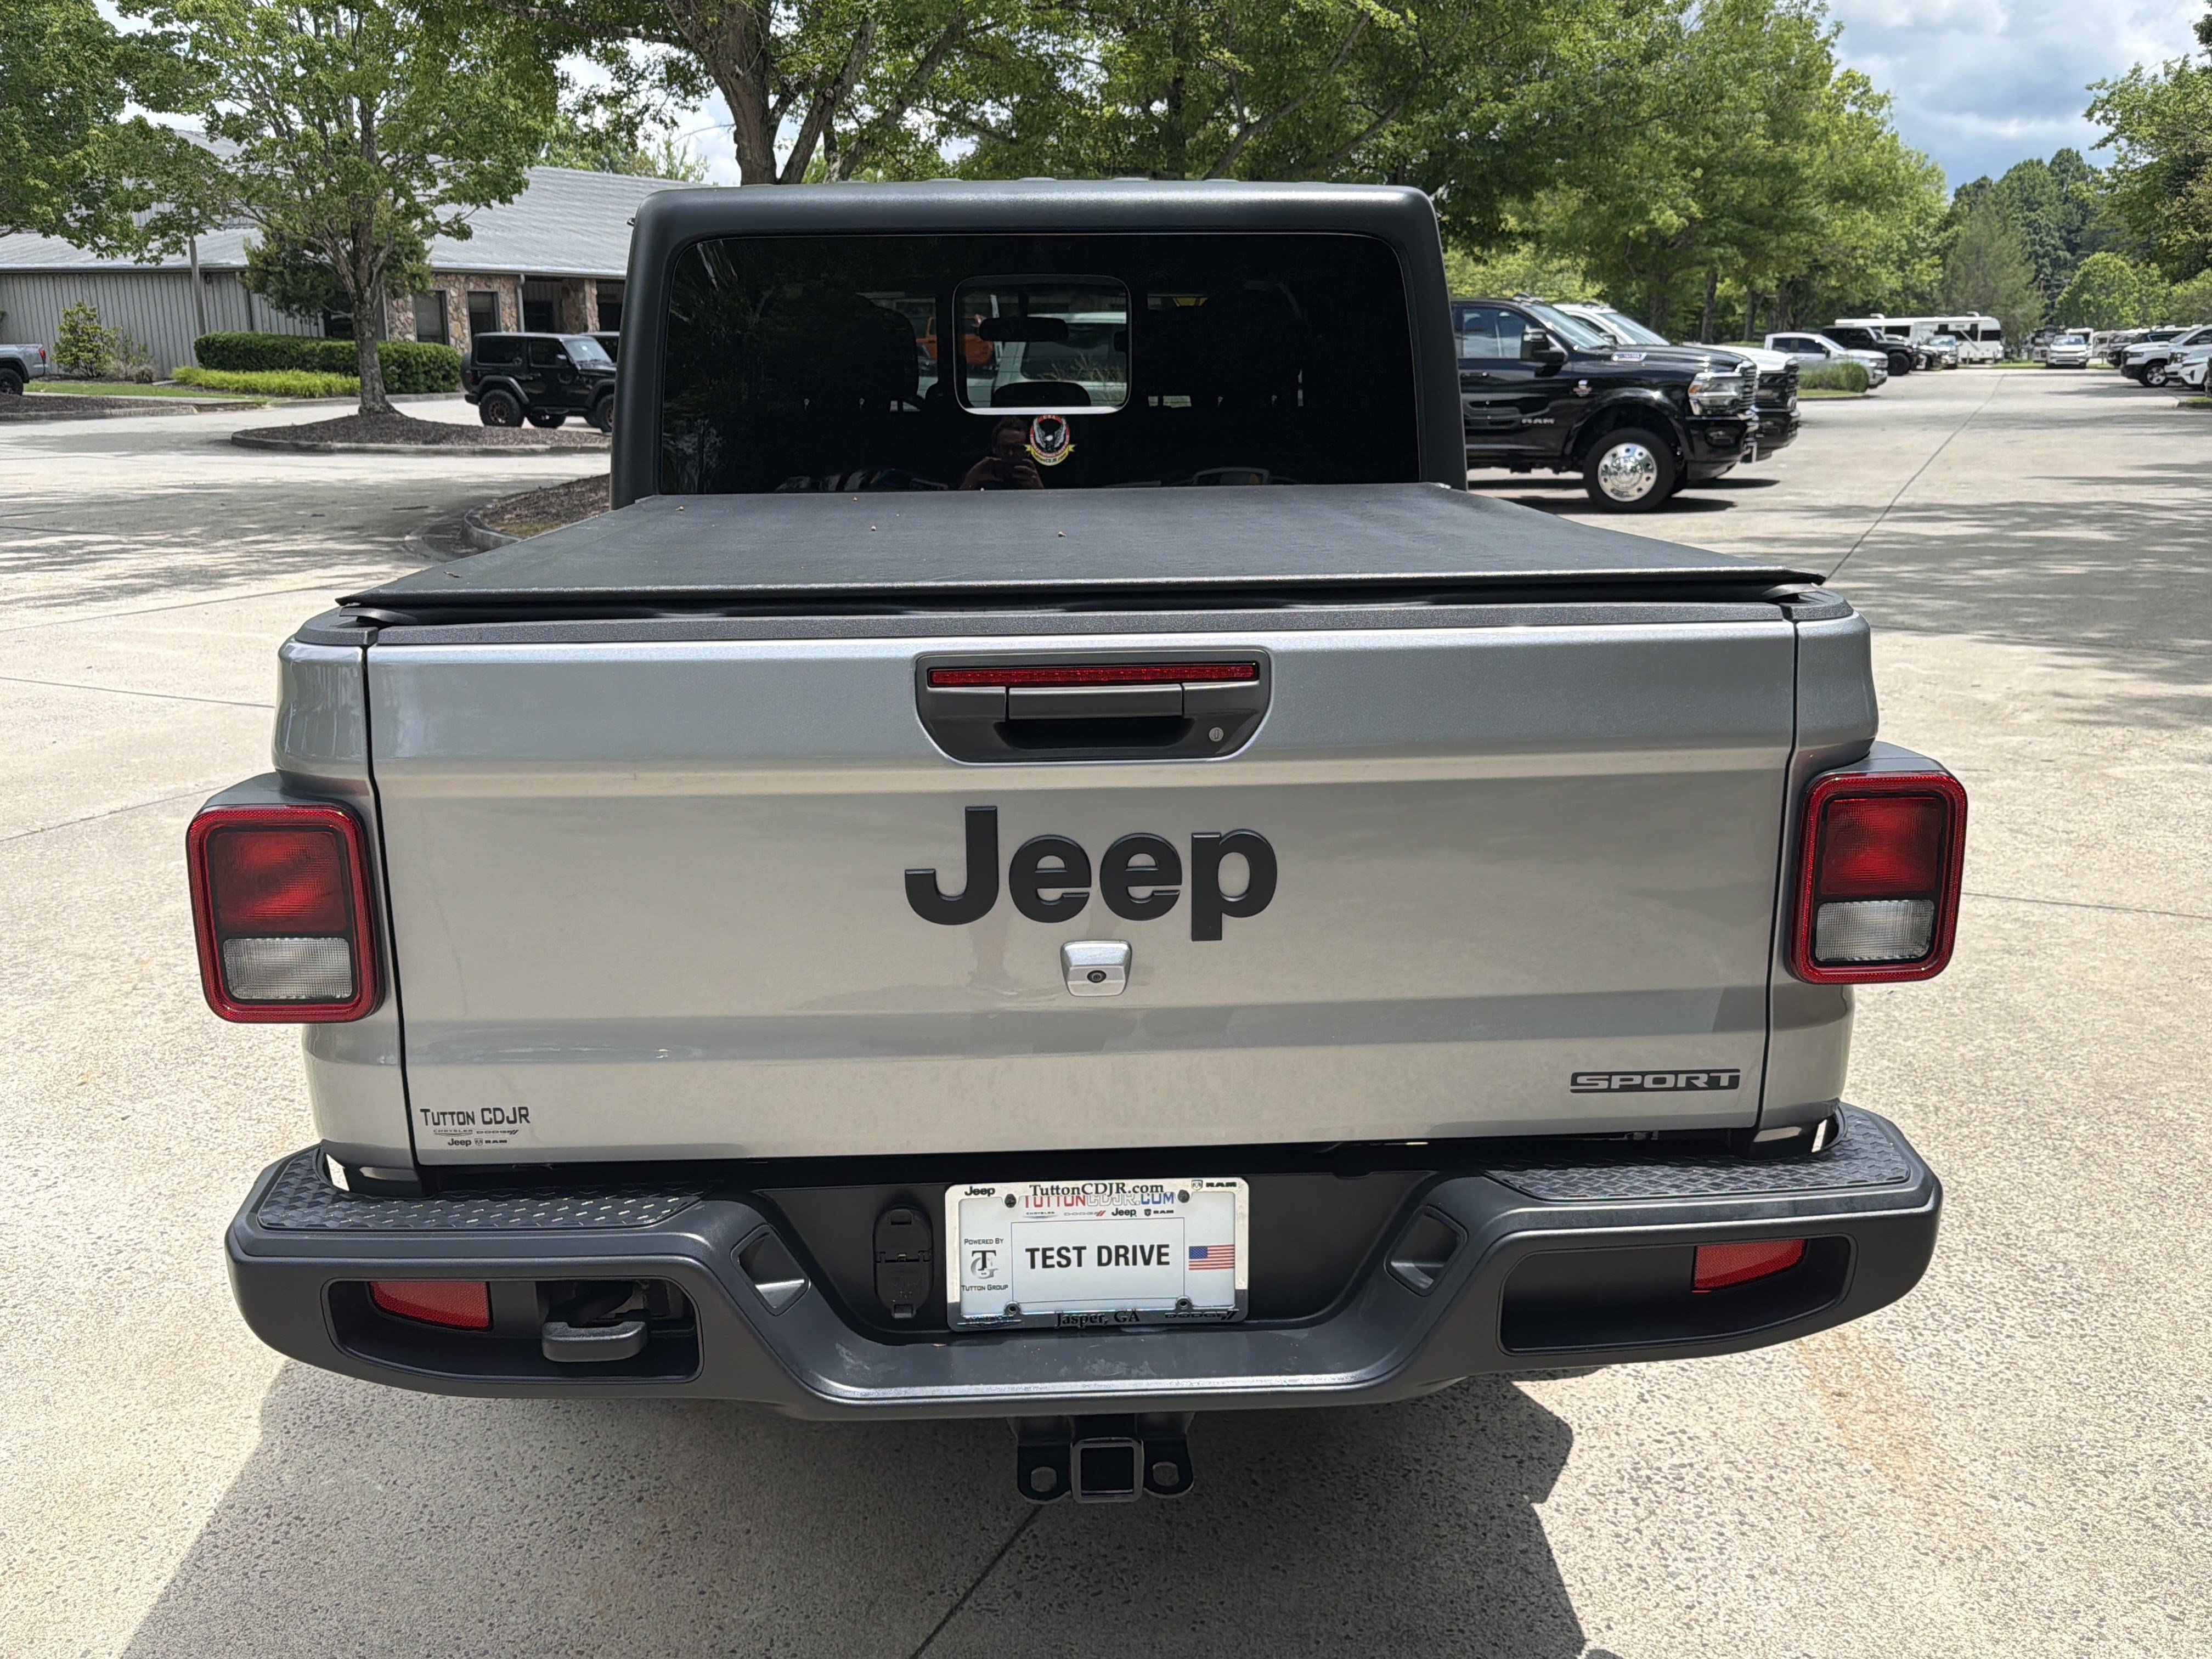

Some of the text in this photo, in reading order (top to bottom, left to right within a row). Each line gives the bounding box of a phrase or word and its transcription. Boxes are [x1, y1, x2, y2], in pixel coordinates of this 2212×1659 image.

[905, 805, 1277, 941] Jeep
[1570, 1070, 1741, 1091] SPORT
[420, 1106, 531, 1126] TUTTON CDJR
[447, 1138, 472, 1147] Jeep
[964, 1186, 996, 1197] Jeep
[1029, 1181, 1164, 1197] TuttonCDJR.com
[1111, 1207, 1137, 1217] Jeep
[1025, 1244, 1170, 1269] TEST DRIVE
[1054, 1309, 1140, 1329] Jasper, GA
